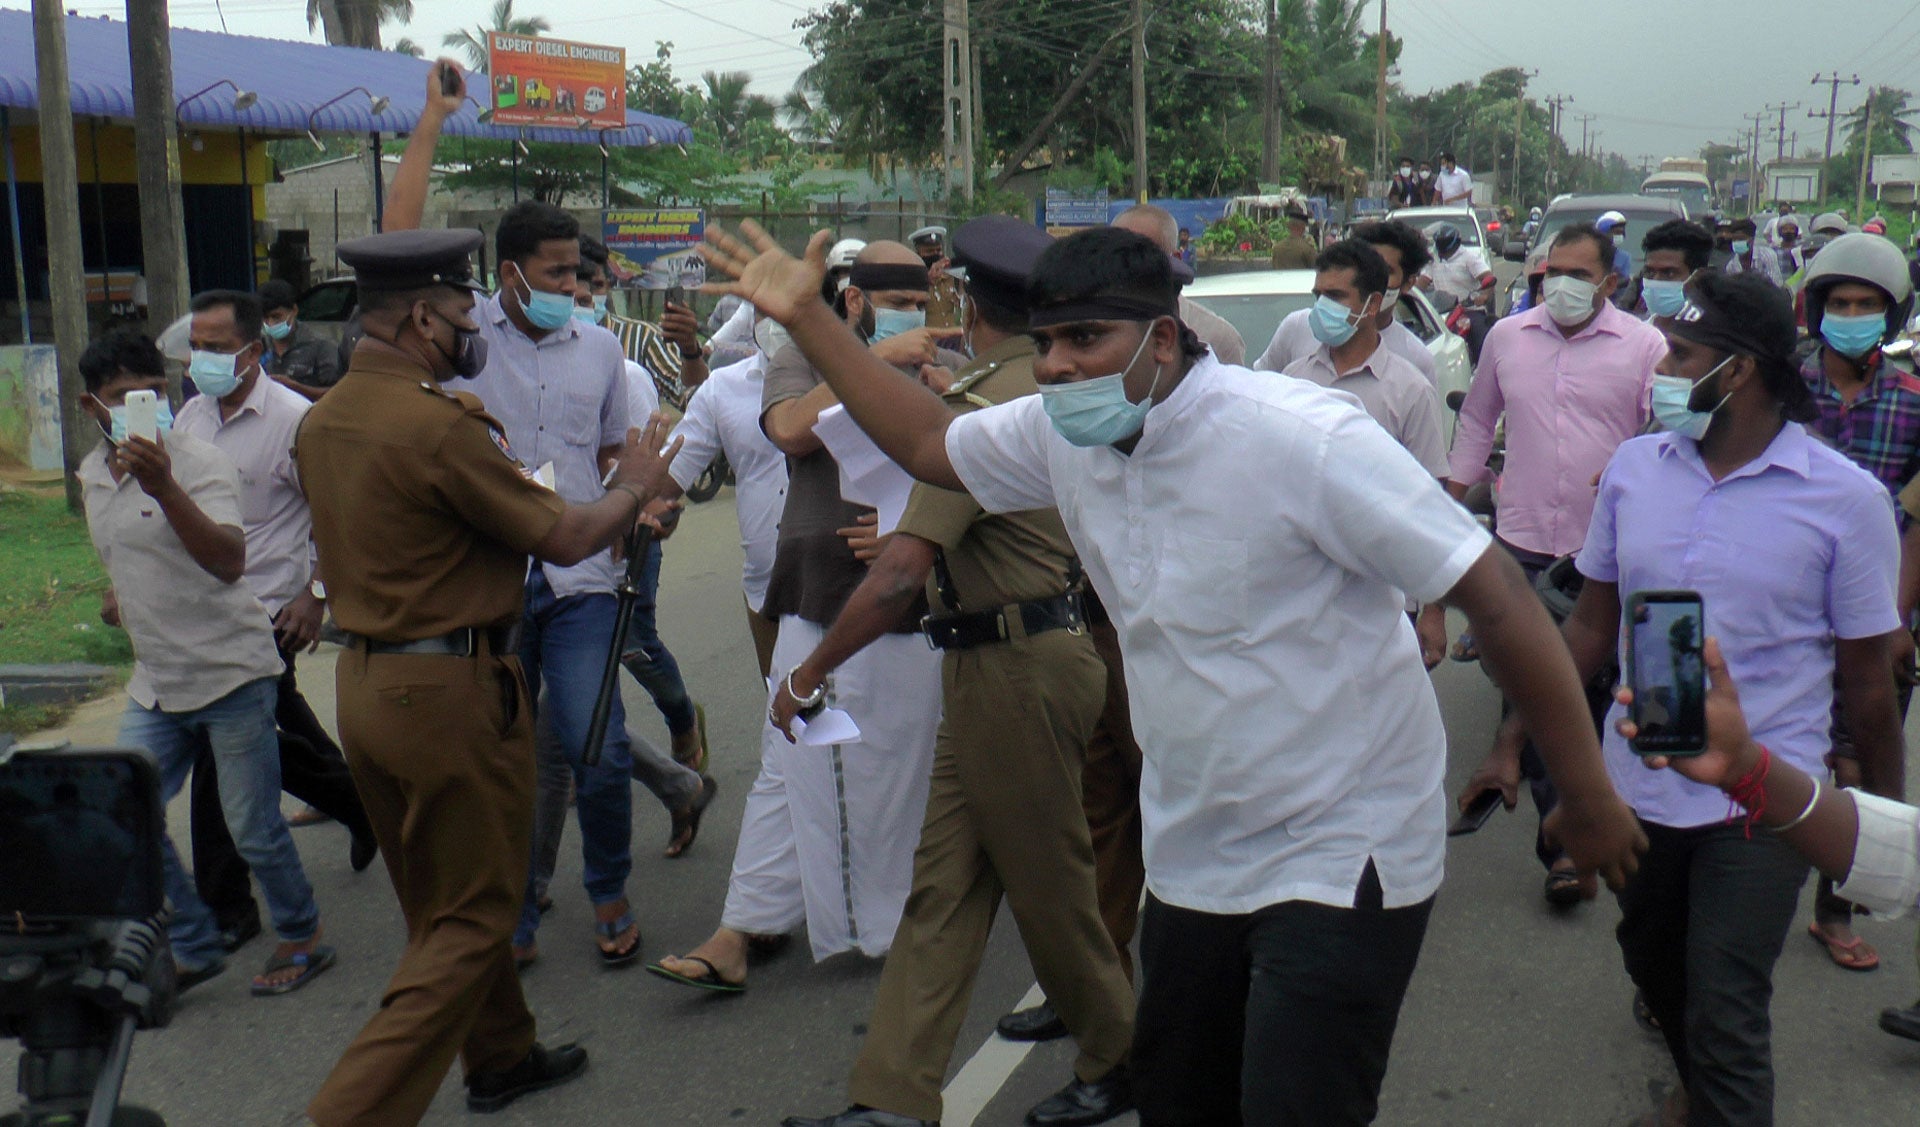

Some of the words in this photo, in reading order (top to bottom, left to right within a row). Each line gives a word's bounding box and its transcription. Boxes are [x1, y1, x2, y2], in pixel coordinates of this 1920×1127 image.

[495, 36, 533, 53] EXPERT
[536, 42, 568, 57] DIESEL
[571, 47, 620, 64] ENGINEERS
[607, 212, 656, 223] EXPERT
[617, 224, 690, 234] ENGINEERS
